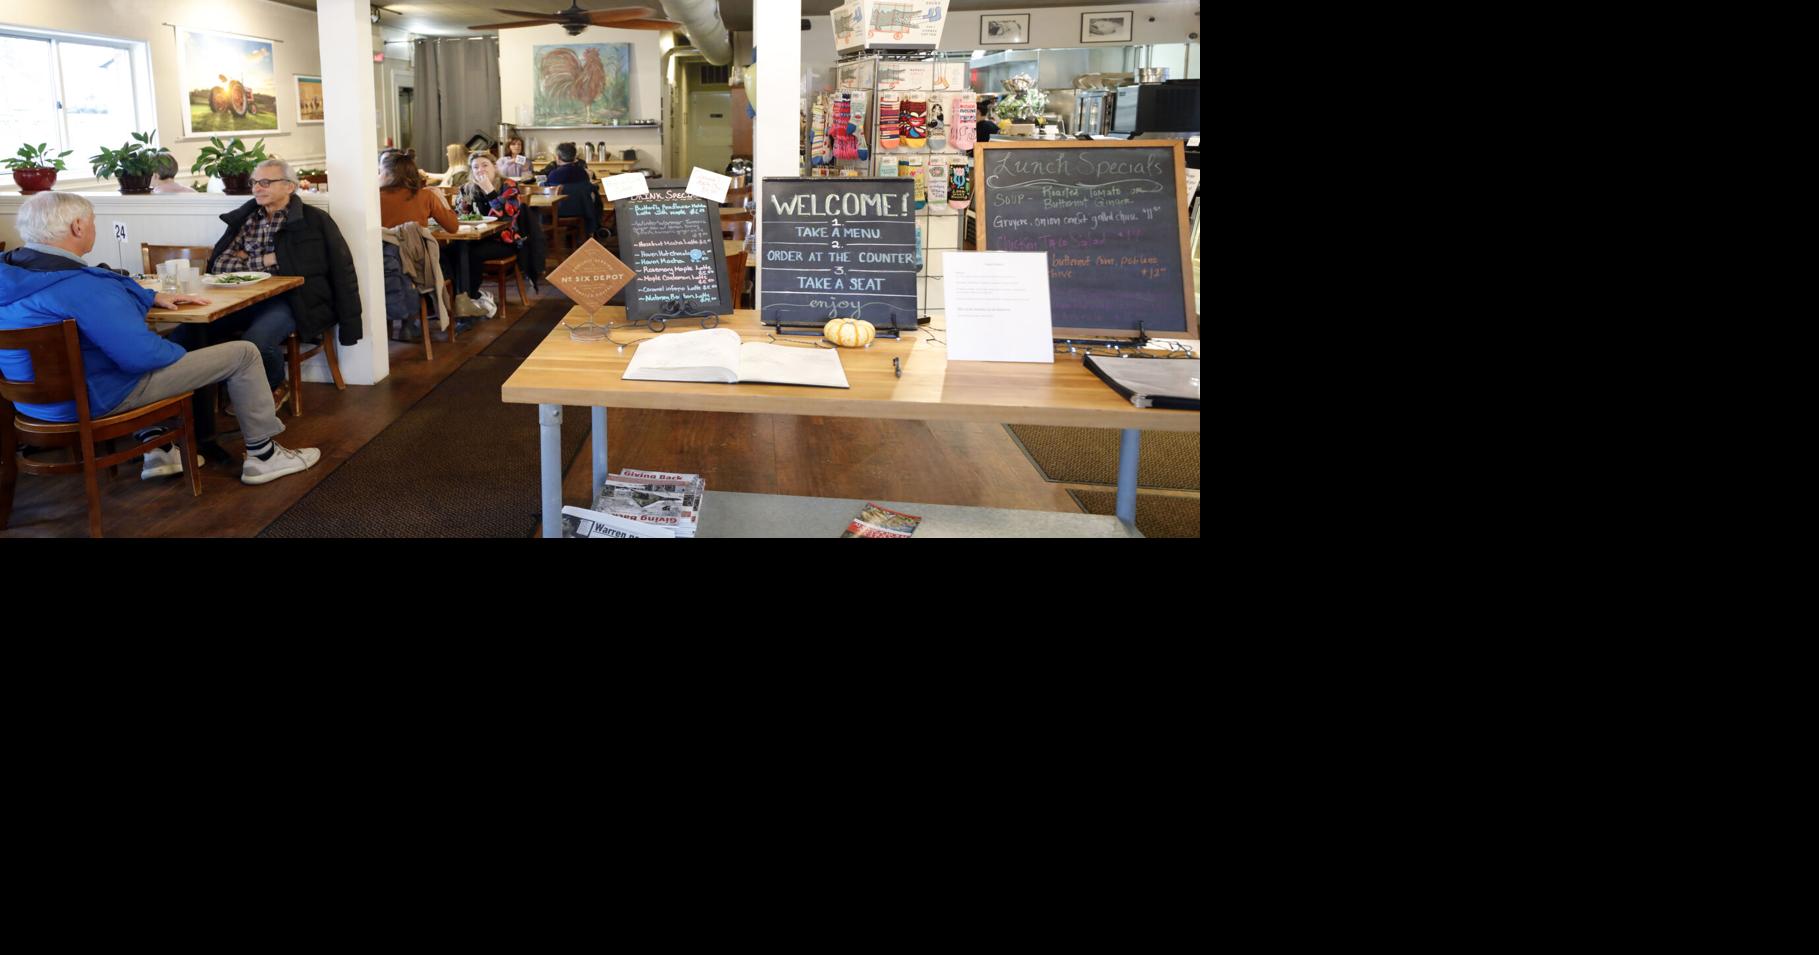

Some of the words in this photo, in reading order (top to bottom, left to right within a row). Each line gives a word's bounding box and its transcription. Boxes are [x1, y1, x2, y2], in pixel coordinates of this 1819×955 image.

[993, 151, 1070, 177] Lunch
[1079, 152, 1163, 178] Specials
[771, 192, 910, 217] WELCOME!
[1035, 216, 1061, 227] onion
[115, 224, 126, 239] 24
[795, 226, 829, 238] TAKE
[831, 227, 840, 237] A
[843, 228, 881, 239] MENU
[767, 250, 803, 262] ORDER
[808, 252, 823, 262] AT
[828, 252, 850, 263] THE
[858, 252, 914, 264] COUNTER
[575, 275, 591, 283] SIX
[593, 273, 625, 281] DEPOT
[797, 276, 832, 289] TAKE
[834, 278, 843, 289] A
[849, 278, 886, 291] SEAT
[809, 297, 862, 319] enjoy
[640, 514, 678, 524] Giving
[595, 523, 627, 538] Warren
